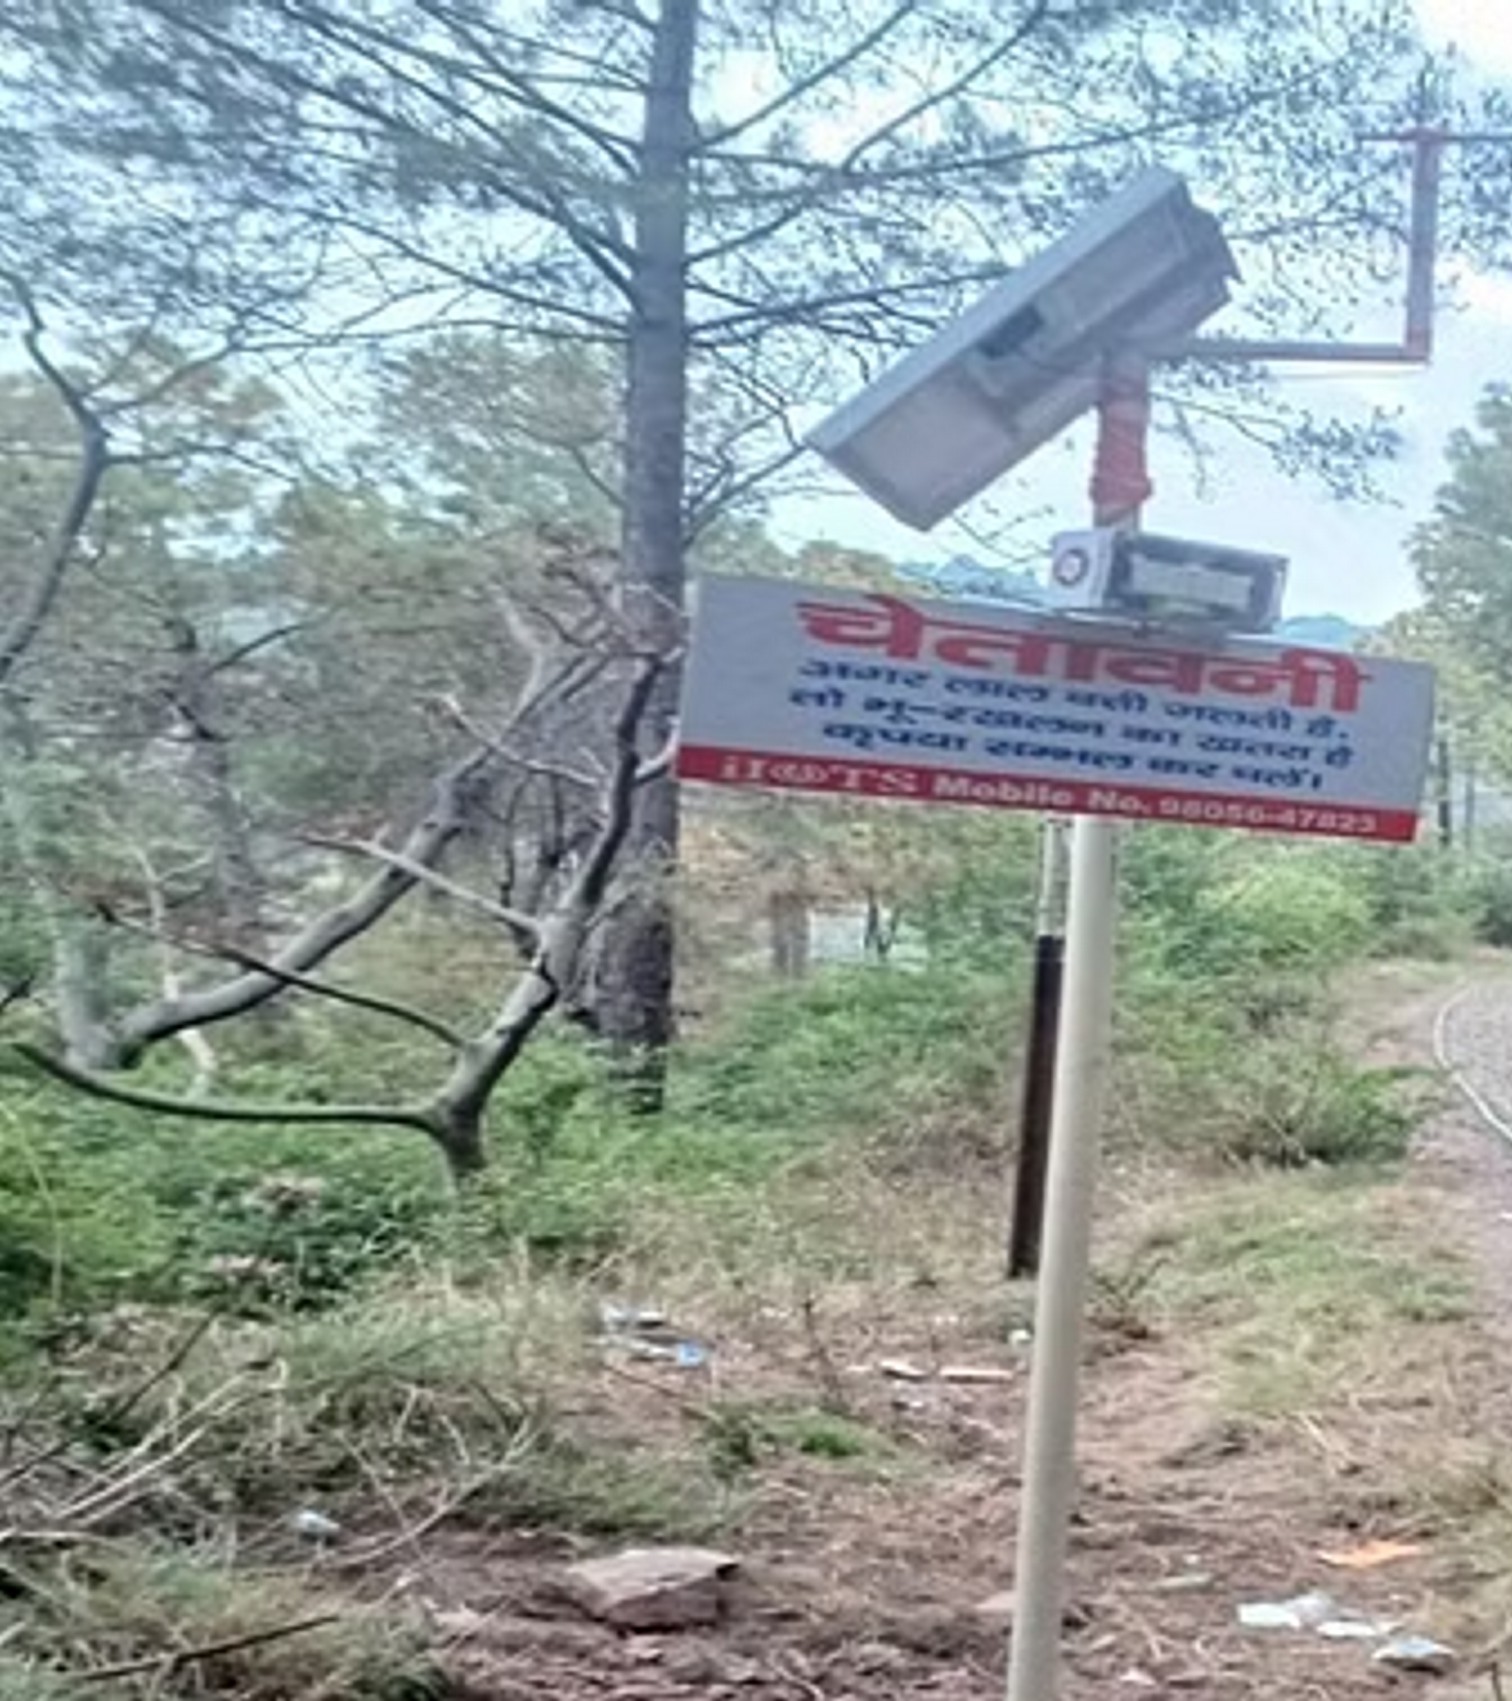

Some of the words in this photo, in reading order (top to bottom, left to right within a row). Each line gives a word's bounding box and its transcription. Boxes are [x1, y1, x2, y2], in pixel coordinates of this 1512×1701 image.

[795, 593, 1372, 712] चेतावनी
[790, 685, 845, 708] तो
[1122, 724, 1182, 747] का
[1196, 735, 1311, 762] खतरा
[1325, 745, 1354, 769] है
[799, 658, 931, 688] अगर
[945, 678, 1049, 702] लाल
[1163, 701, 1293, 730] जलती
[823, 722, 968, 750] कृपया
[1147, 755, 1220, 777] कर
[934, 774, 1074, 806] Mobile
